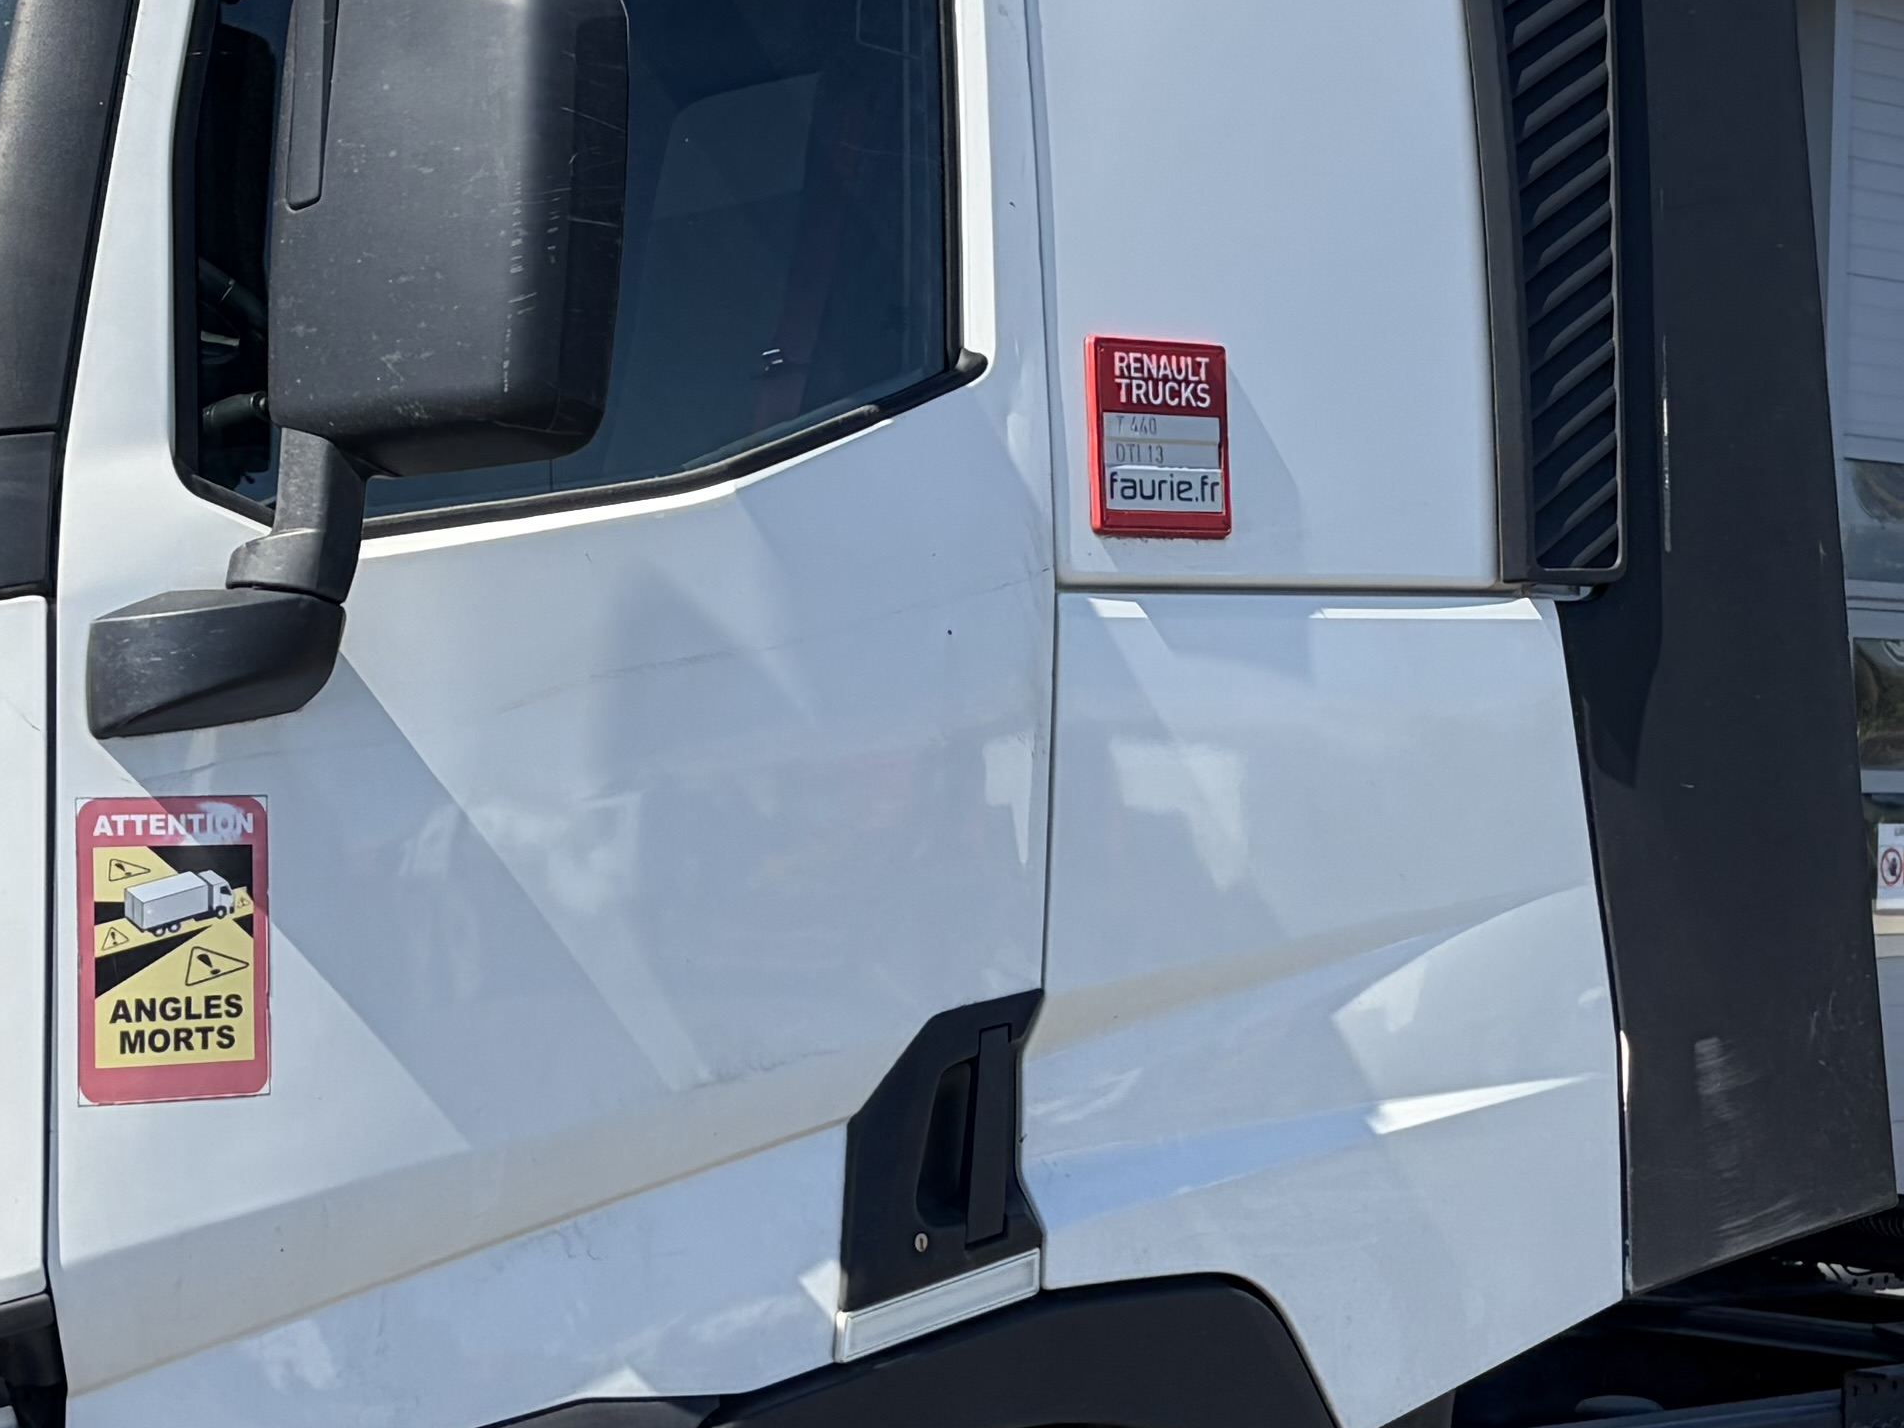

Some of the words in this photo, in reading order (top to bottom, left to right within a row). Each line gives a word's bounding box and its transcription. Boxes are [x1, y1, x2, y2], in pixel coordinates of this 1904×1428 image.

[1114, 351, 1210, 381] RENAULT
[1114, 378, 1211, 408] TRUCKS
[1130, 416, 1157, 435] 440
[1148, 444, 1164, 464] 13
[1109, 471, 1221, 503] faurie.fr
[92, 812, 254, 837] ATTENTION
[108, 993, 244, 1024] ANGLES
[119, 1024, 236, 1055] MORTS
